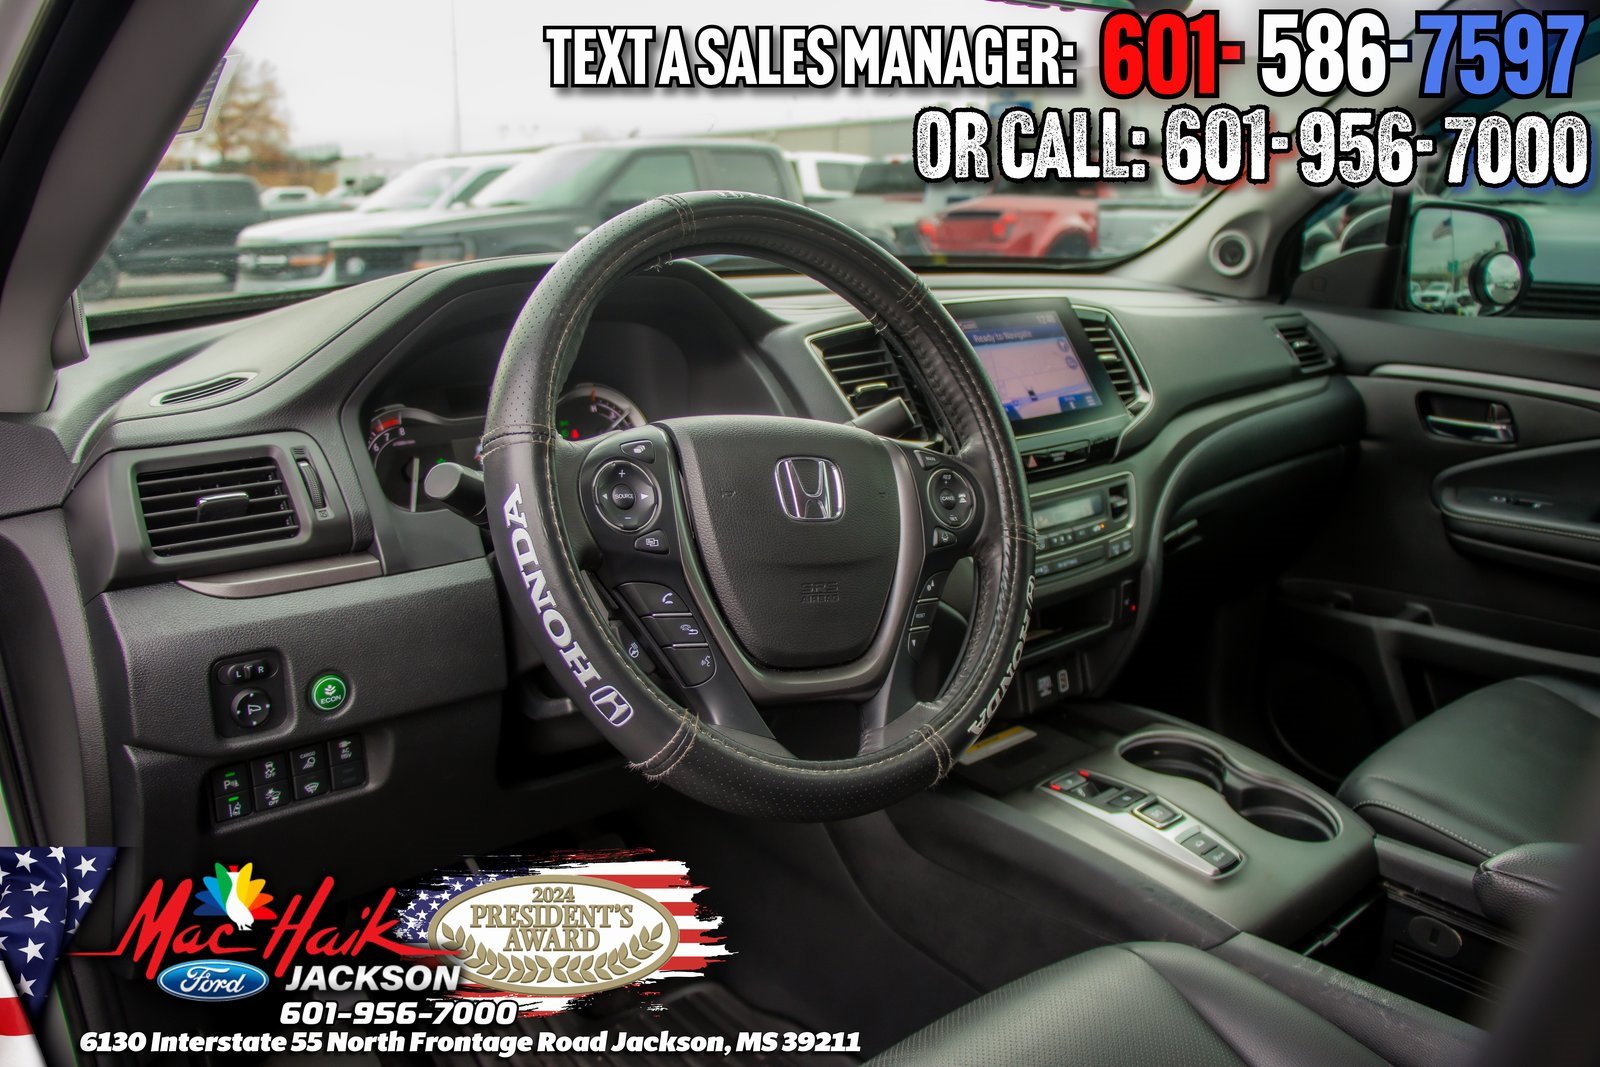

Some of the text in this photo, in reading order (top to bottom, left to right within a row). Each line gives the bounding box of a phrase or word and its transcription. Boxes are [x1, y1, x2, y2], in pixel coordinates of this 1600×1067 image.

[384, 433, 390, 441] 7
[503, 484, 602, 688] HONDA
[258, 666, 264, 674] R
[320, 695, 342, 704] ECON
[268, 798, 279, 806] OFF
